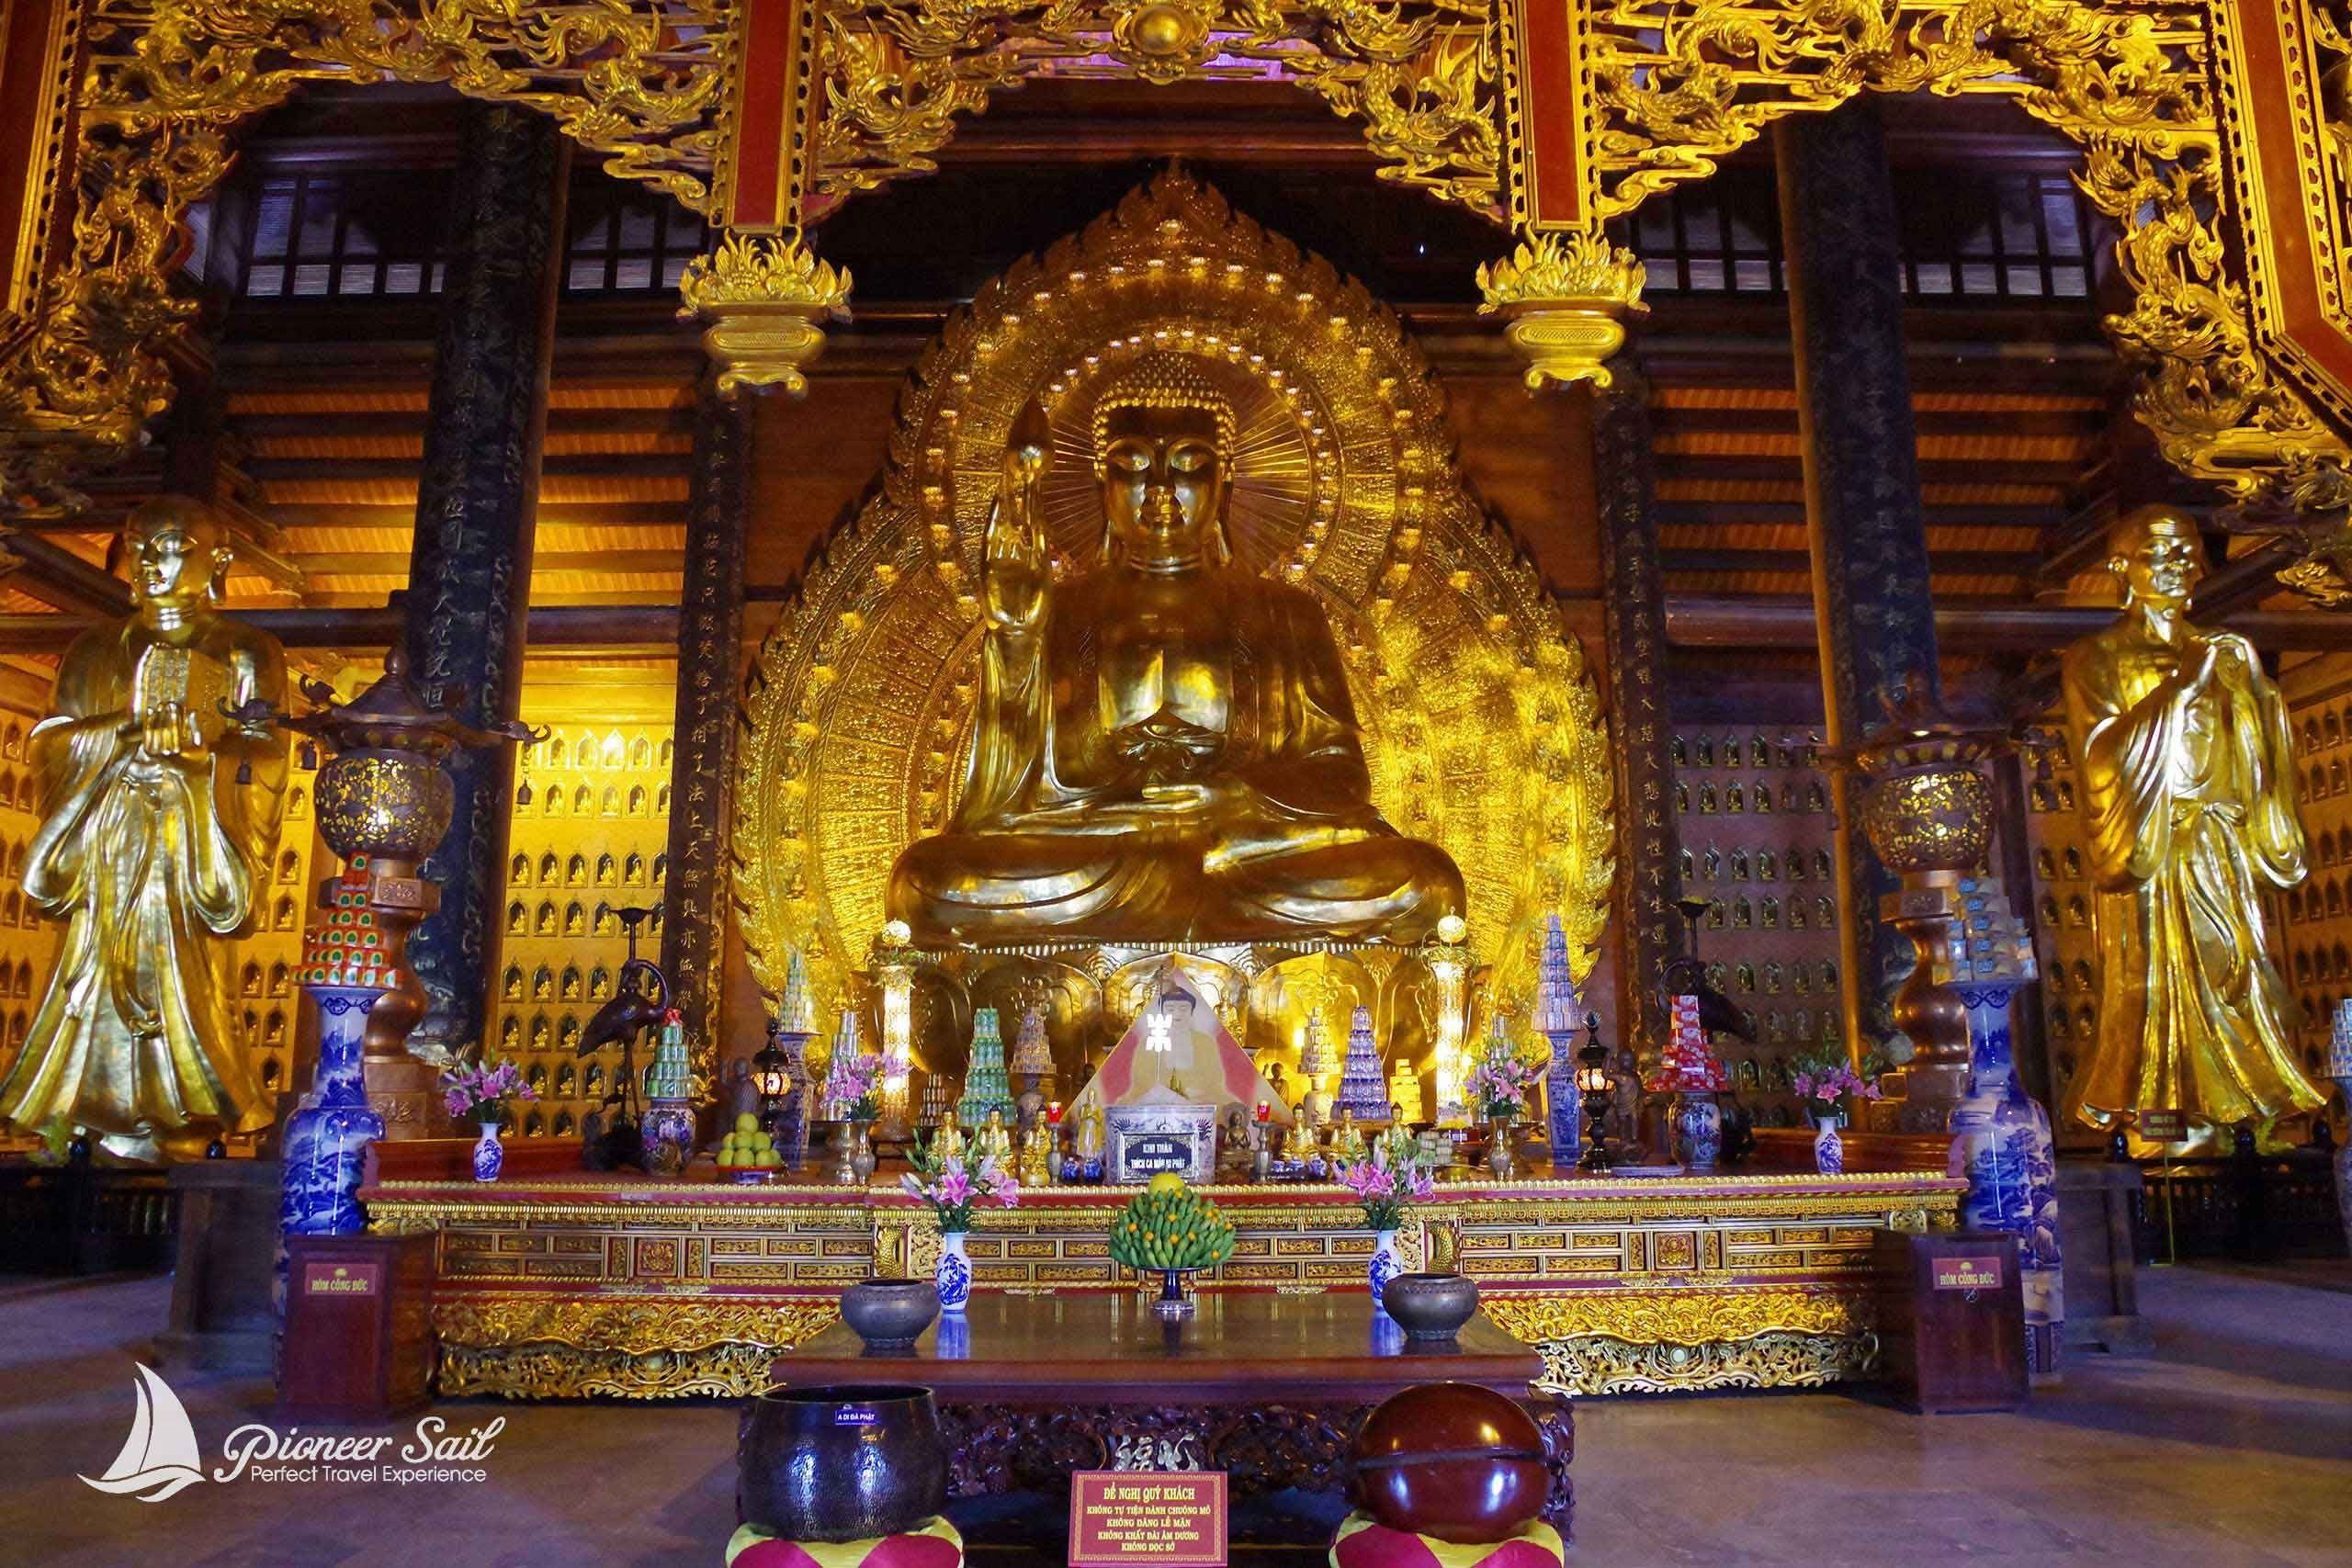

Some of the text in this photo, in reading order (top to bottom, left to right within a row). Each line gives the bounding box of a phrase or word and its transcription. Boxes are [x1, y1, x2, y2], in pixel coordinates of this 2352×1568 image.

[1958, 1272, 1978, 1285] CÔNG
[1979, 1271, 1995, 1284] ĐỨC
[331, 1278, 350, 1292] CÔNG
[352, 1278, 368, 1292] ĐỨC
[860, 1413, 875, 1421] PHẬT
[1103, 1482, 1195, 1503] ĐỀ NGHỊ QUÝ KHÁCH
[1087, 1505, 1113, 1515] KHÔNG
[1114, 1506, 1125, 1516] TỰ
[1125, 1505, 1144, 1516] TIỆN
[1106, 1517, 1135, 1528] KHÔNG
[1098, 1529, 1124, 1540] KHÔNG
[1121, 1542, 1148, 1551] KHÔNG
[1148, 1542, 1164, 1552] ĐỌC
